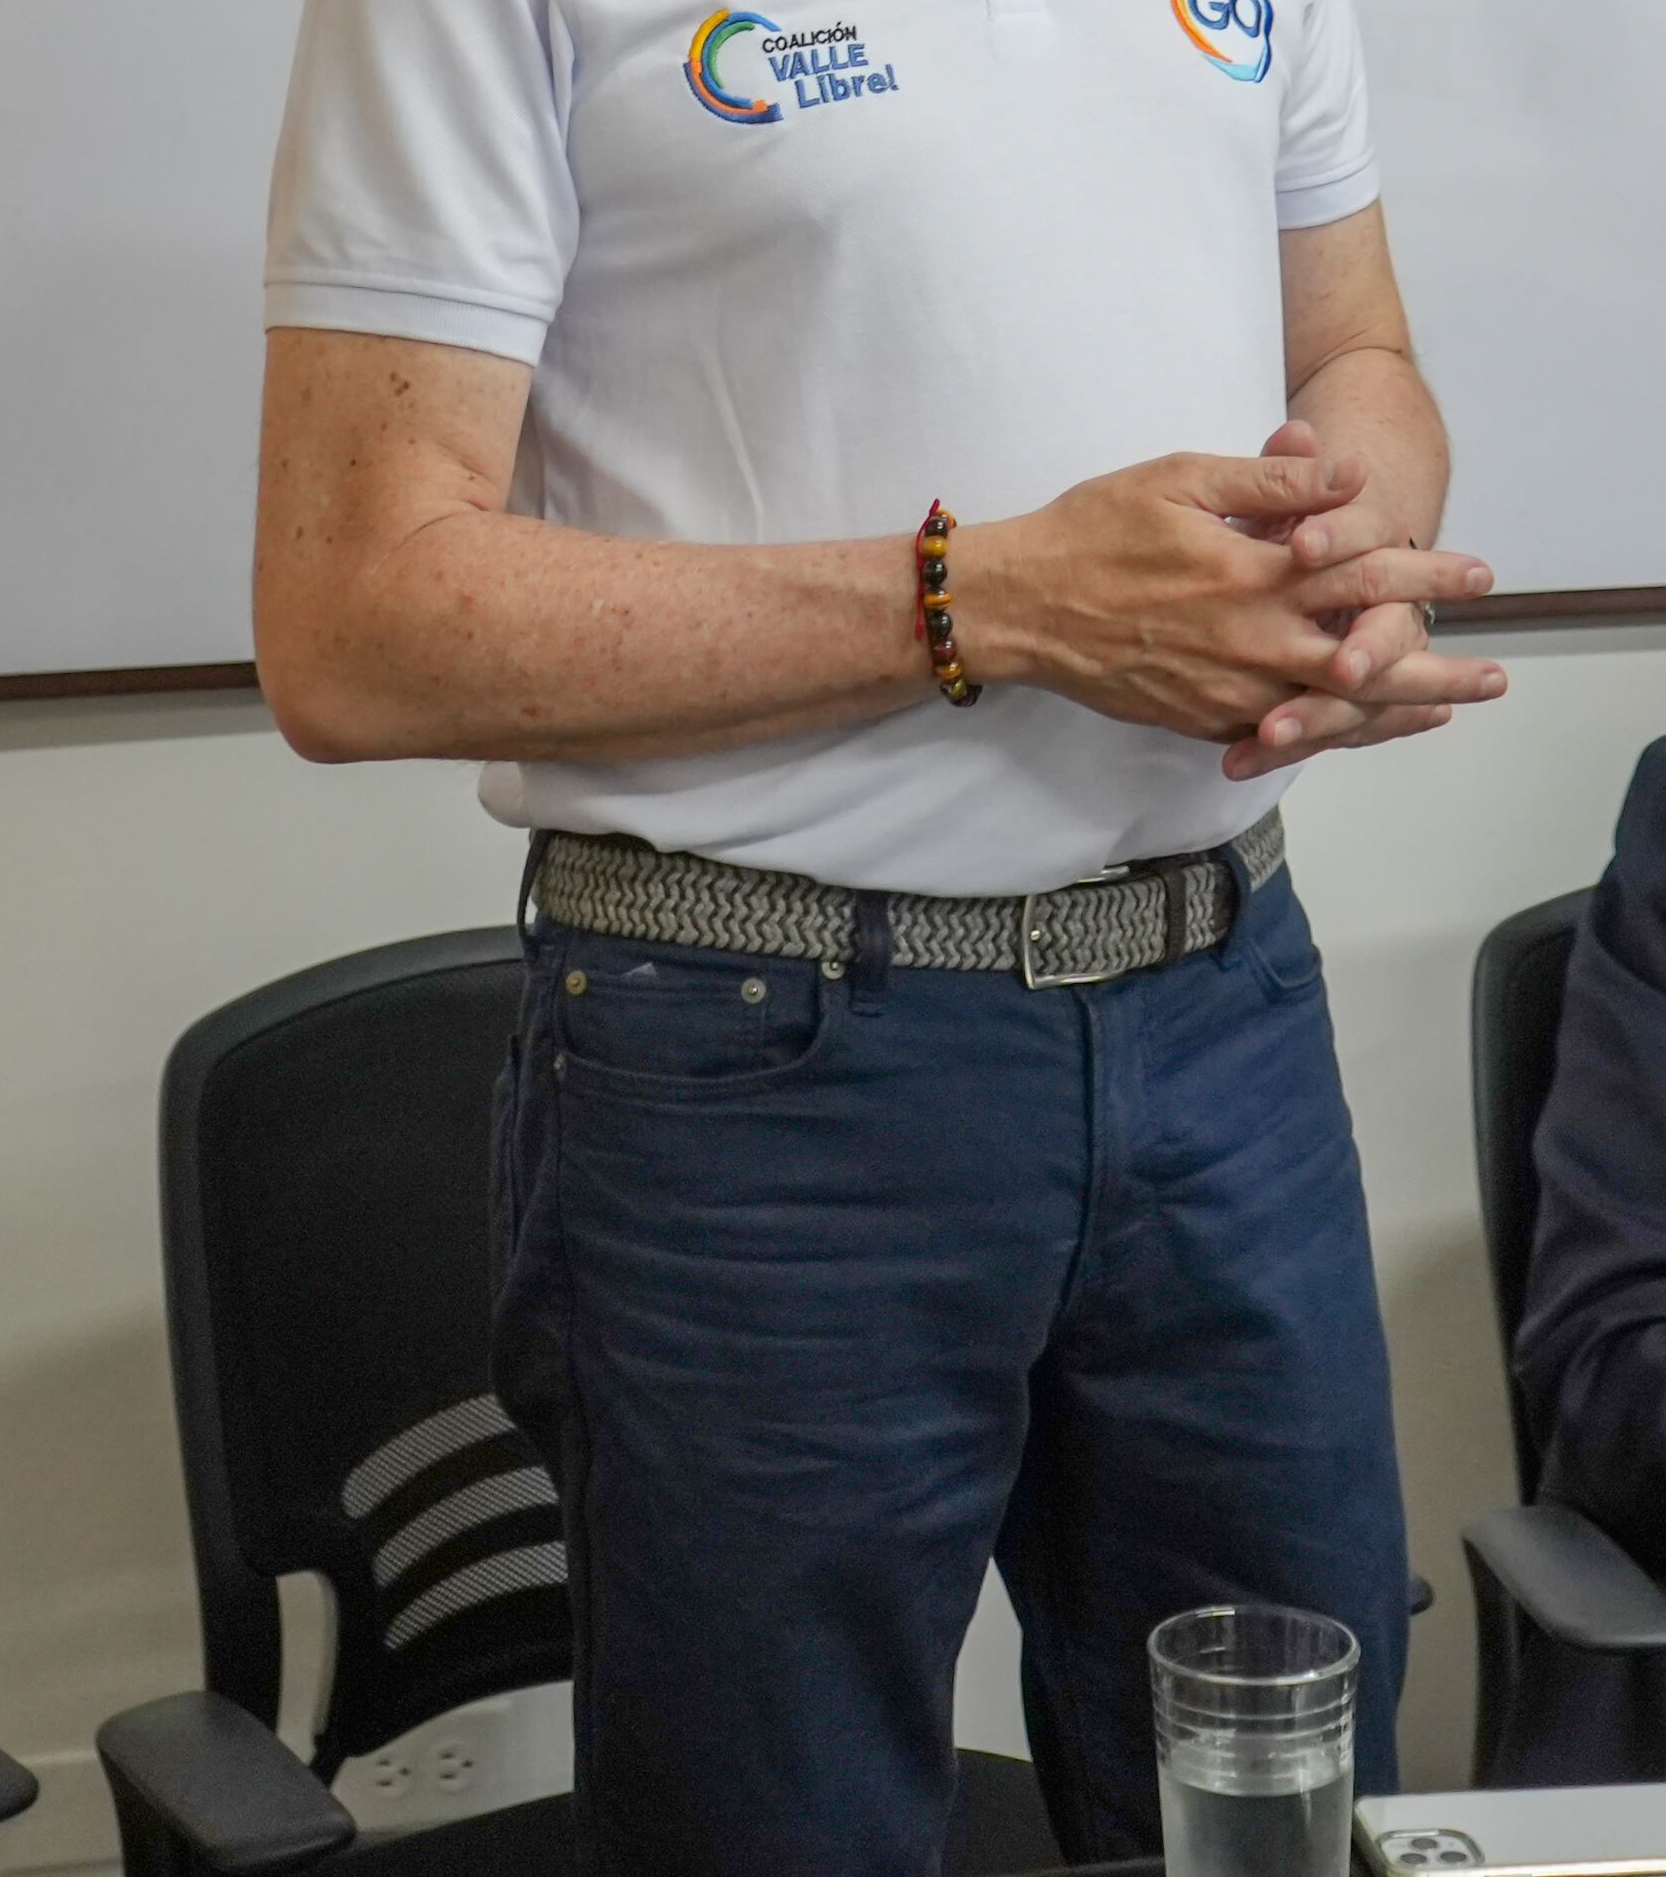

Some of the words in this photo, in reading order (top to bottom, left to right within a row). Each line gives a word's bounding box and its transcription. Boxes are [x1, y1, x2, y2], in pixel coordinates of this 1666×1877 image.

[762, 22, 857, 53] COALICIÓN
[768, 43, 869, 82] VALLE
[795, 64, 899, 109] Libre!
